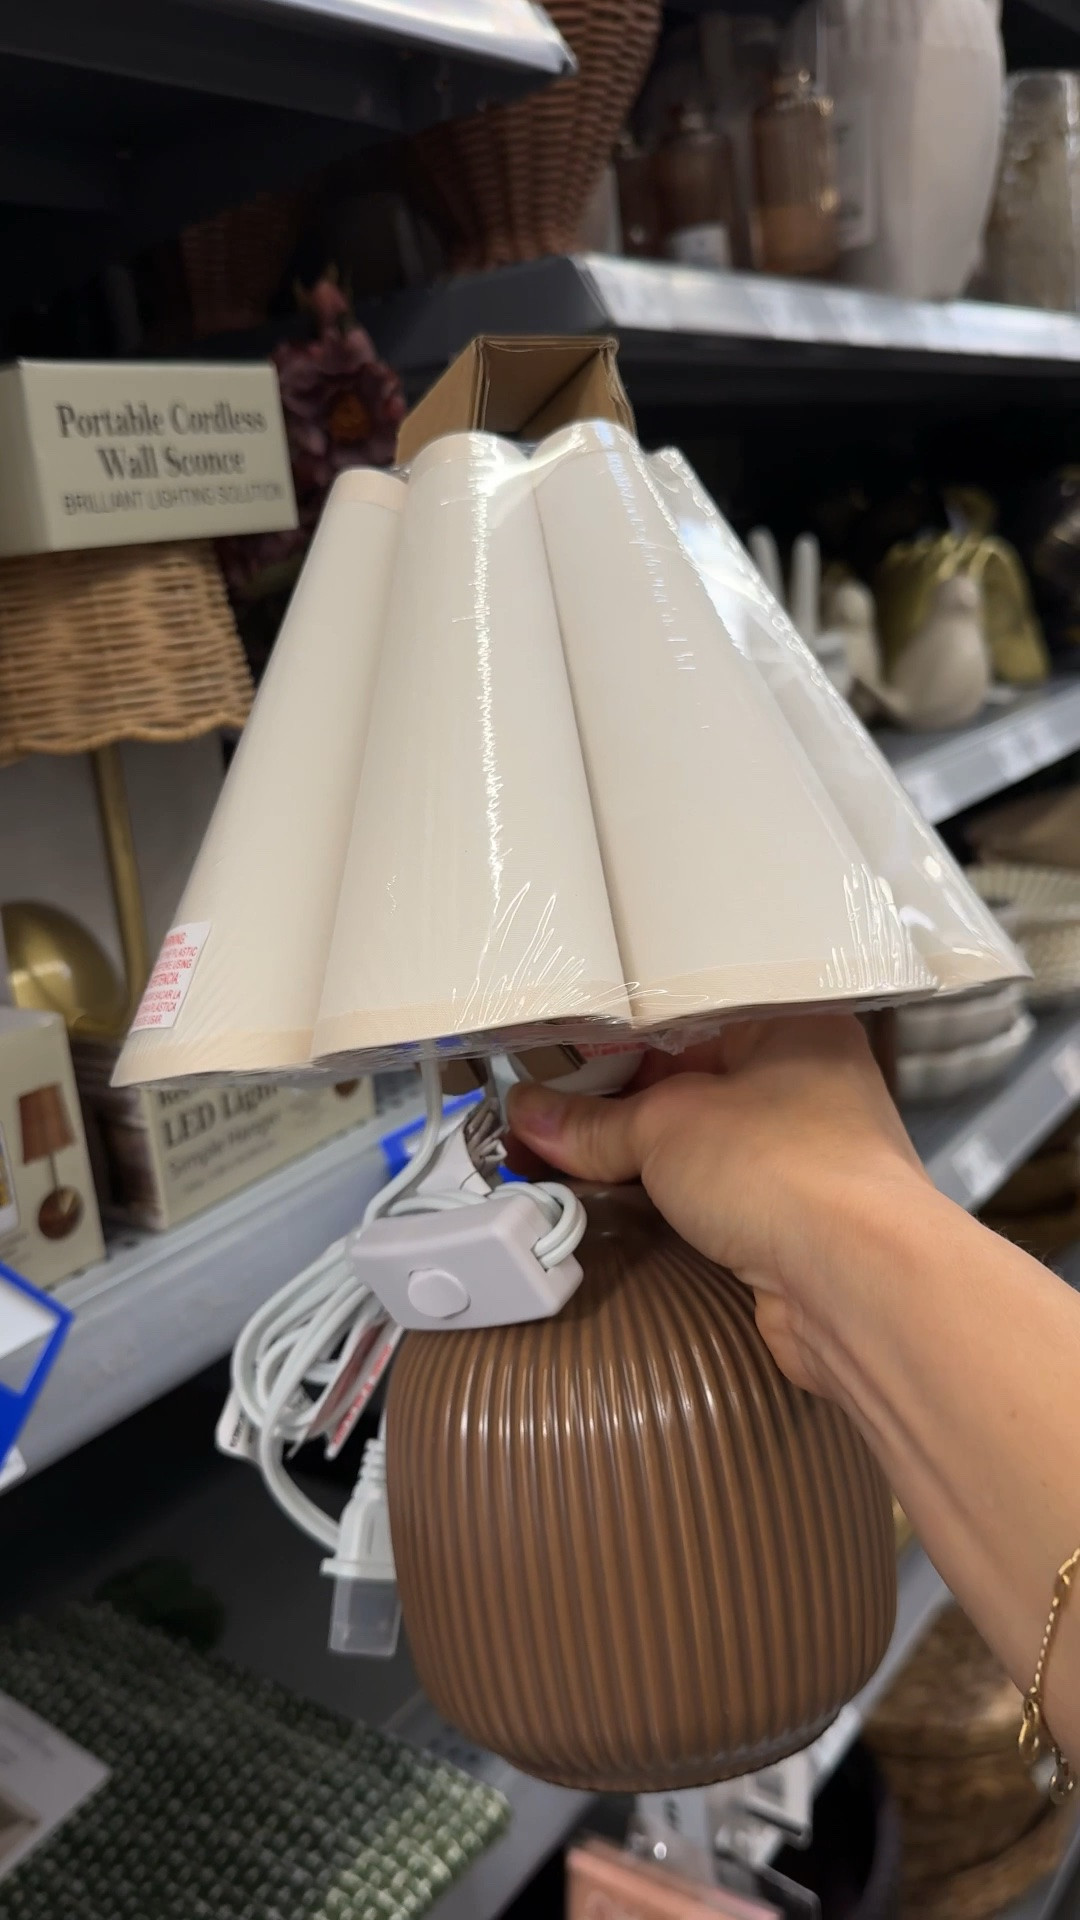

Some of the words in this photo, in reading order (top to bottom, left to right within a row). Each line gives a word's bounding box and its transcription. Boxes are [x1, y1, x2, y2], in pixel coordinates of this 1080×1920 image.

[56, 402, 164, 437] Portable
[168, 401, 267, 435] Cordless
[97, 447, 158, 480] Wall
[163, 446, 246, 477] Sconce
[63, 491, 143, 516] BRILLIANT
[147, 486, 216, 511] LIGHTING
[161, 1101, 216, 1147] LED
